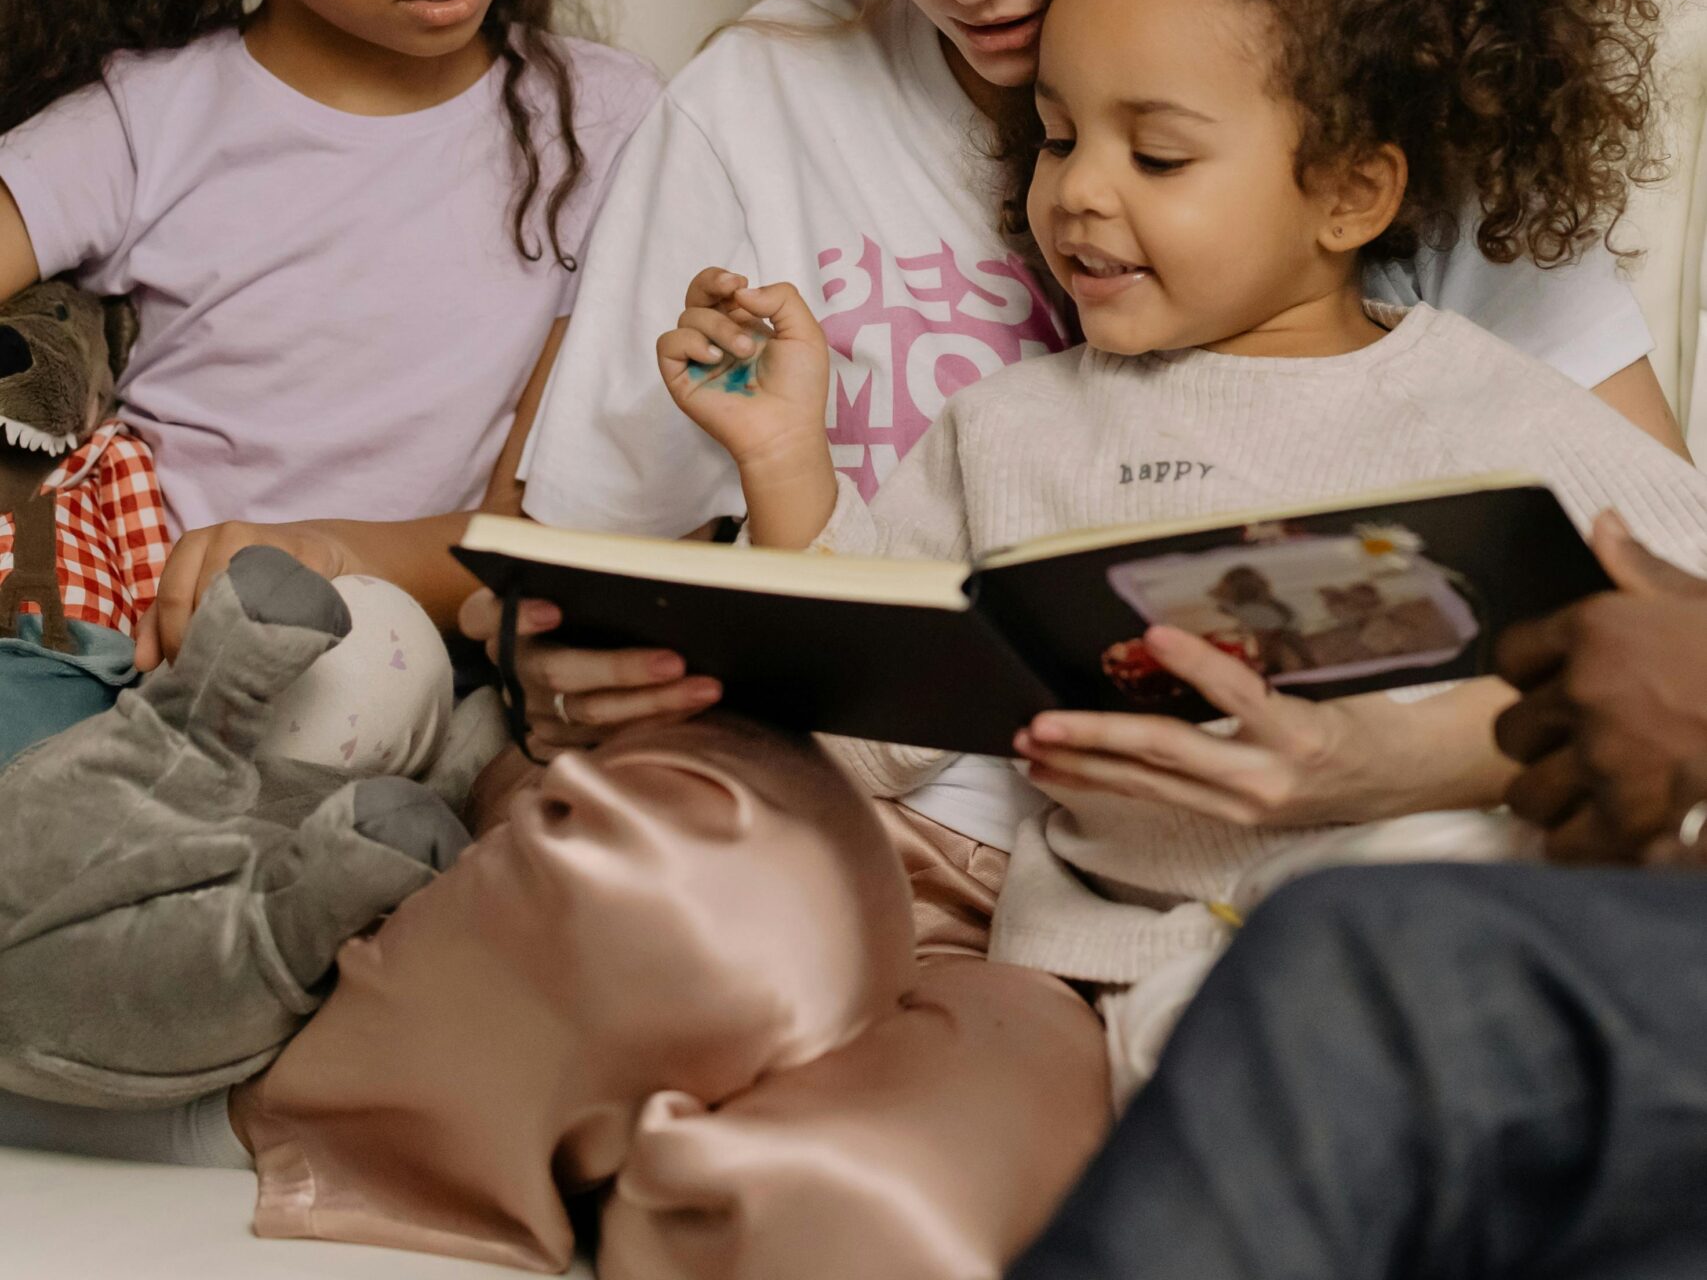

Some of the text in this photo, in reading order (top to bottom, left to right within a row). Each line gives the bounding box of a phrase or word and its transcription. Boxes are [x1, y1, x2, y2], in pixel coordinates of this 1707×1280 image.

[807, 234, 1050, 327] BES
[824, 323, 1049, 429] MO
[1119, 461, 1214, 484] happy
